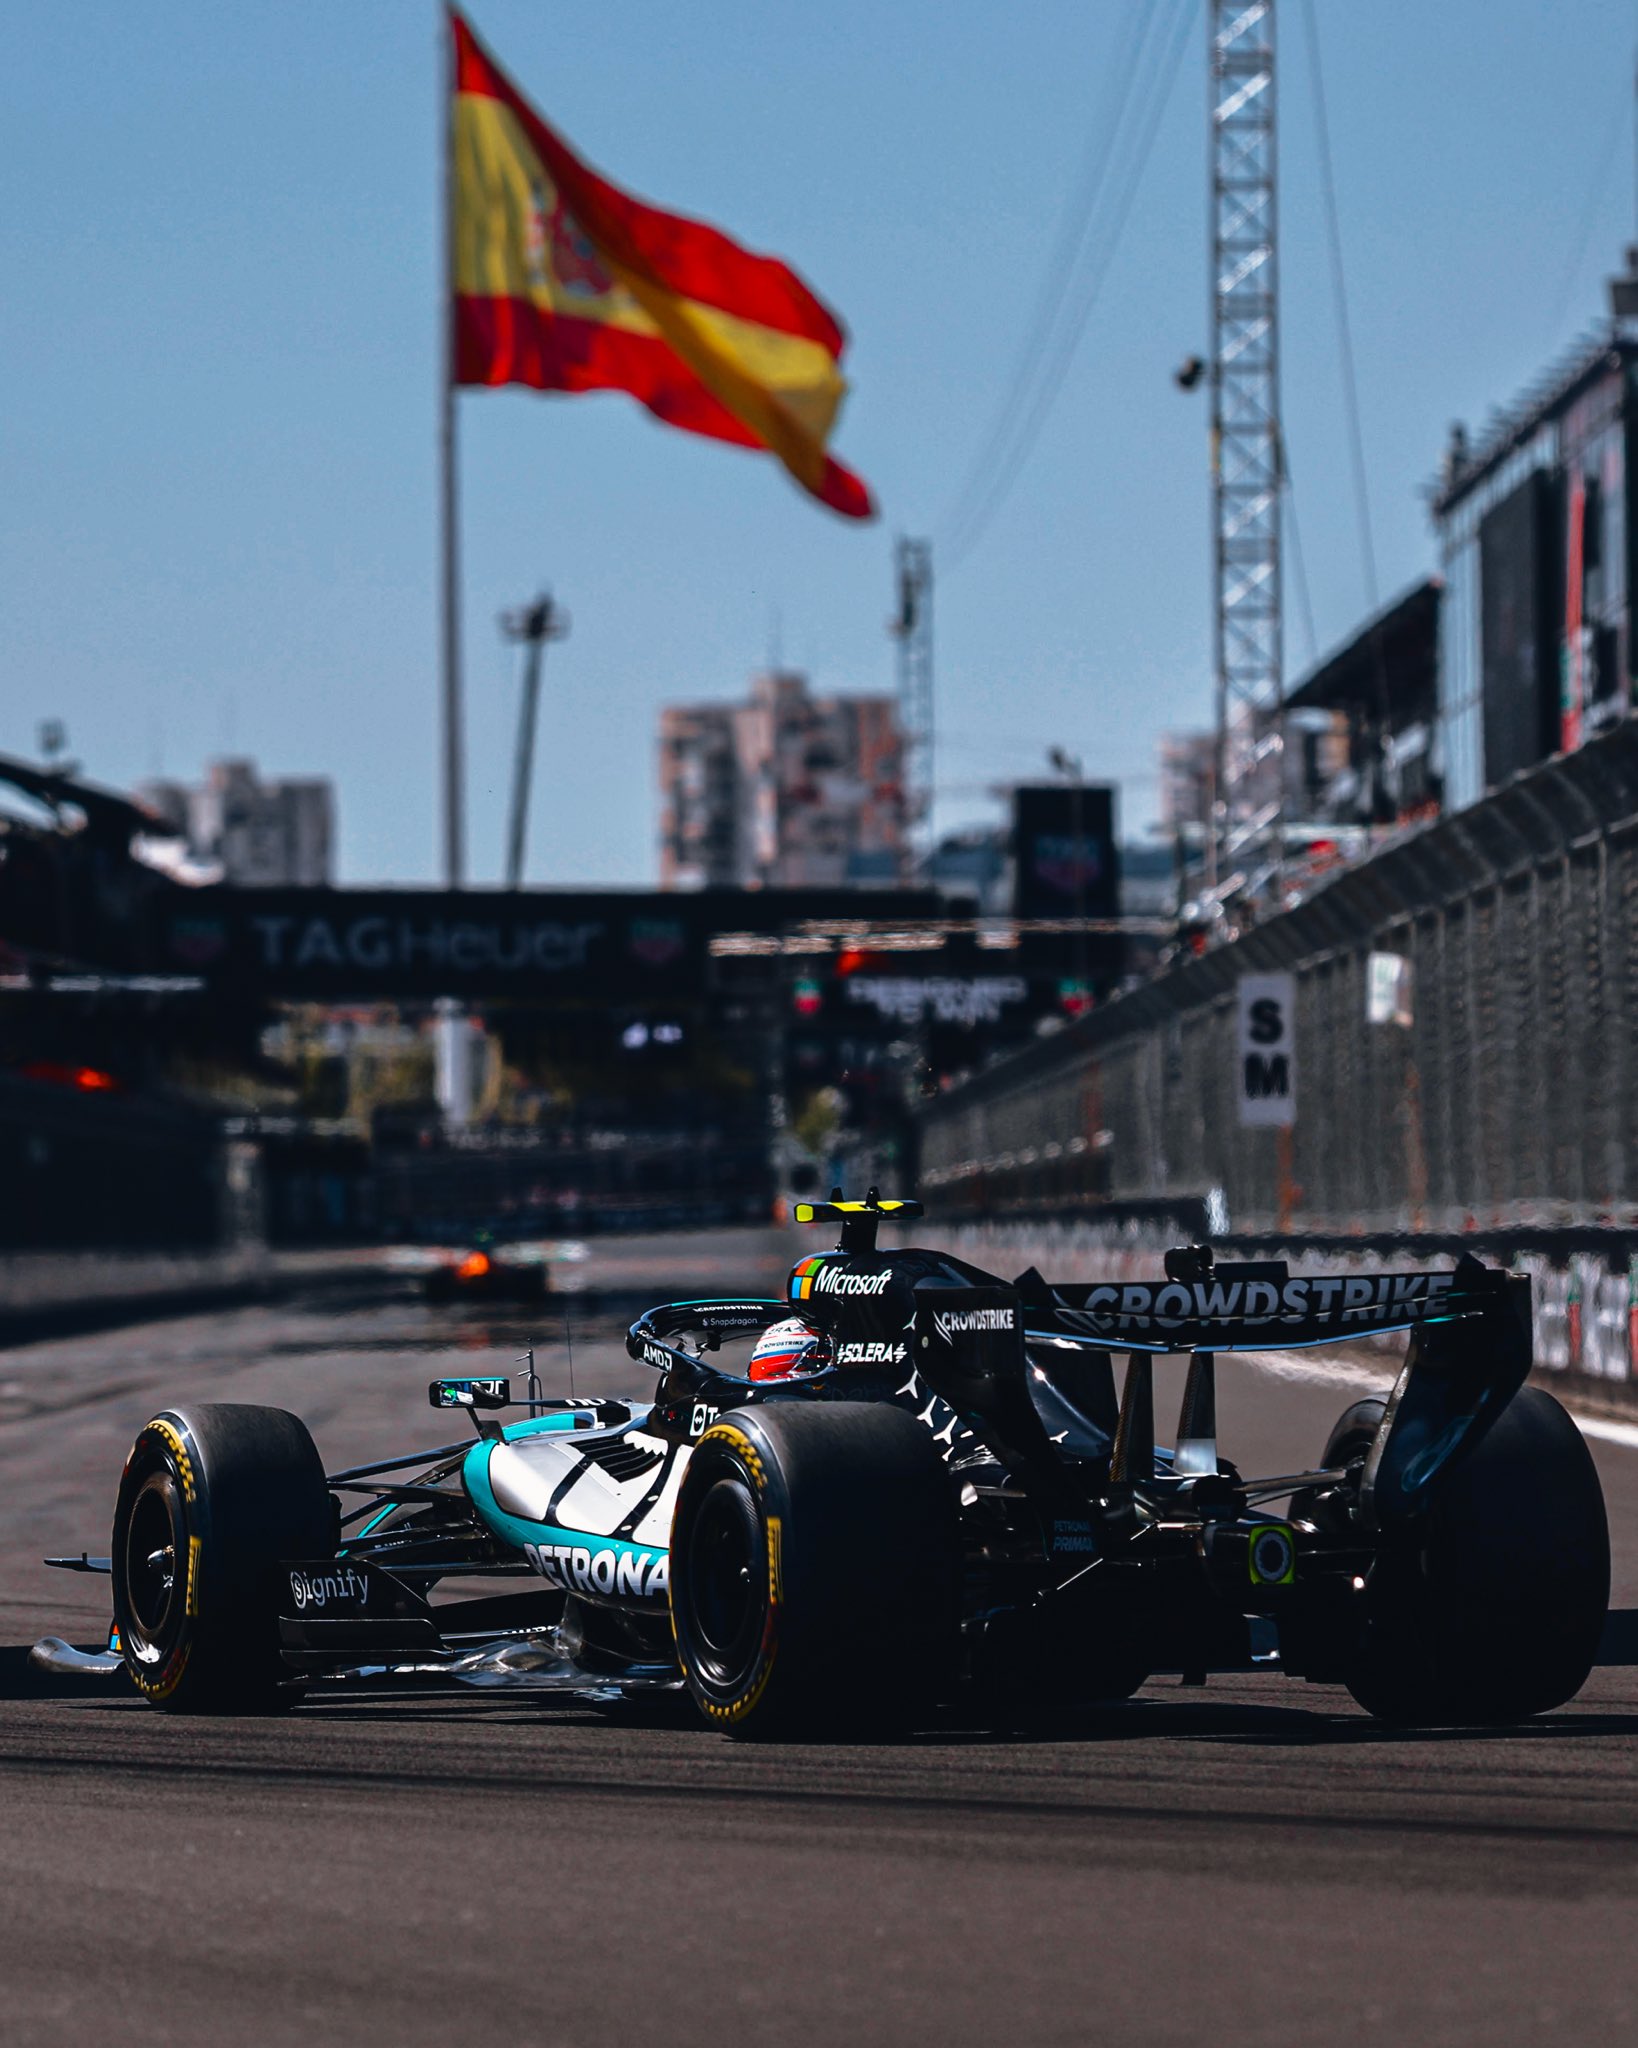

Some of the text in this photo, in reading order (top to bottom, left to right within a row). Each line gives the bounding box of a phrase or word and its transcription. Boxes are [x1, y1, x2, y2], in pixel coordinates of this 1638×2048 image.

[252, 917, 393, 969] TAG
[1250, 998, 1284, 1045] S
[1245, 1053, 1289, 1100] M
[815, 1265, 893, 1295] Microsoft
[698, 1305, 764, 1313] CROWDSTRIKE
[1083, 1275, 1454, 1329] CROWDSTRIKE
[710, 1317, 758, 1327] Snapdragon
[942, 1309, 1014, 1331] CROWDSTRIKE
[643, 1343, 665, 1367] AMD
[843, 1343, 893, 1363] SOLERA
[523, 1543, 670, 1596] PETRONA
